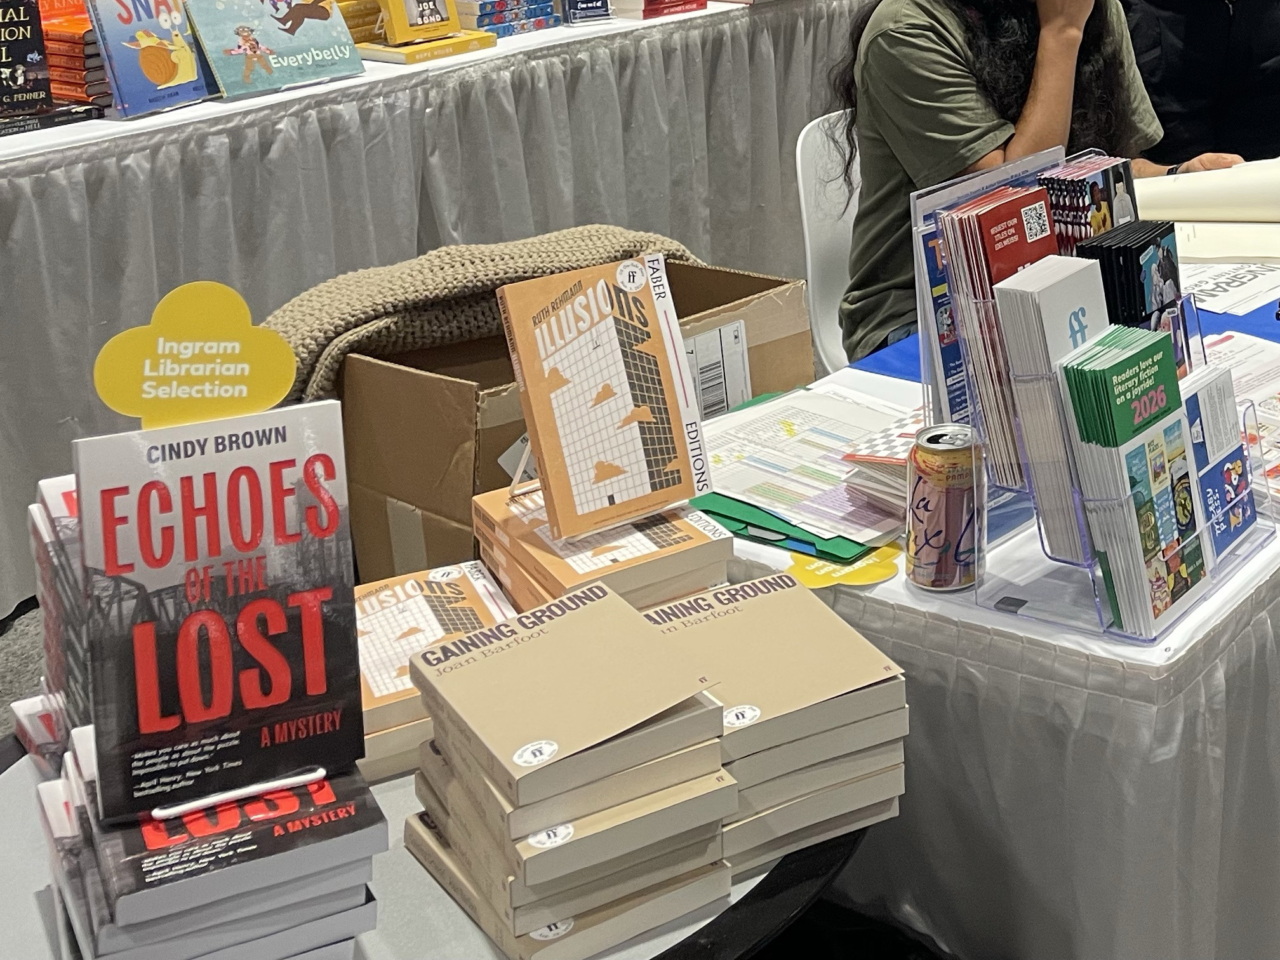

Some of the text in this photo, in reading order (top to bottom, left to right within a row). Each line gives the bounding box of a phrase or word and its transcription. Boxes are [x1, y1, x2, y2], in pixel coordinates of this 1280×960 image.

[417, 1, 435, 10] JOE
[417, 14, 442, 25] BOND
[269, 44, 351, 69] Everybelly
[646, 257, 667, 301] FABER
[531, 279, 583, 329] RUTH REHMANN
[143, 359, 250, 377] Librarian
[157, 337, 241, 360] Ingram
[141, 381, 249, 399] Selection
[1112, 358, 1152, 385] Readers love
[1114, 365, 1159, 395] literary fiction
[1116, 396, 1125, 405] on
[1132, 375, 1155, 398] joyride!
[1131, 384, 1166, 425] 2026
[146, 425, 287, 465] CINDY BROWN
[685, 421, 709, 492] EDITIONS
[100, 452, 341, 577] ECHOES
[185, 555, 269, 603] OF THE
[712, 572, 799, 614] GROUND
[420, 584, 609, 668] GAINING GROUND
[678, 603, 745, 633] Barfoot
[132, 587, 334, 735] LOST
[434, 626, 550, 677] Joan Barfoot
[260, 709, 342, 748] A MYSTERY
[287, 804, 357, 833] MYSTERY
